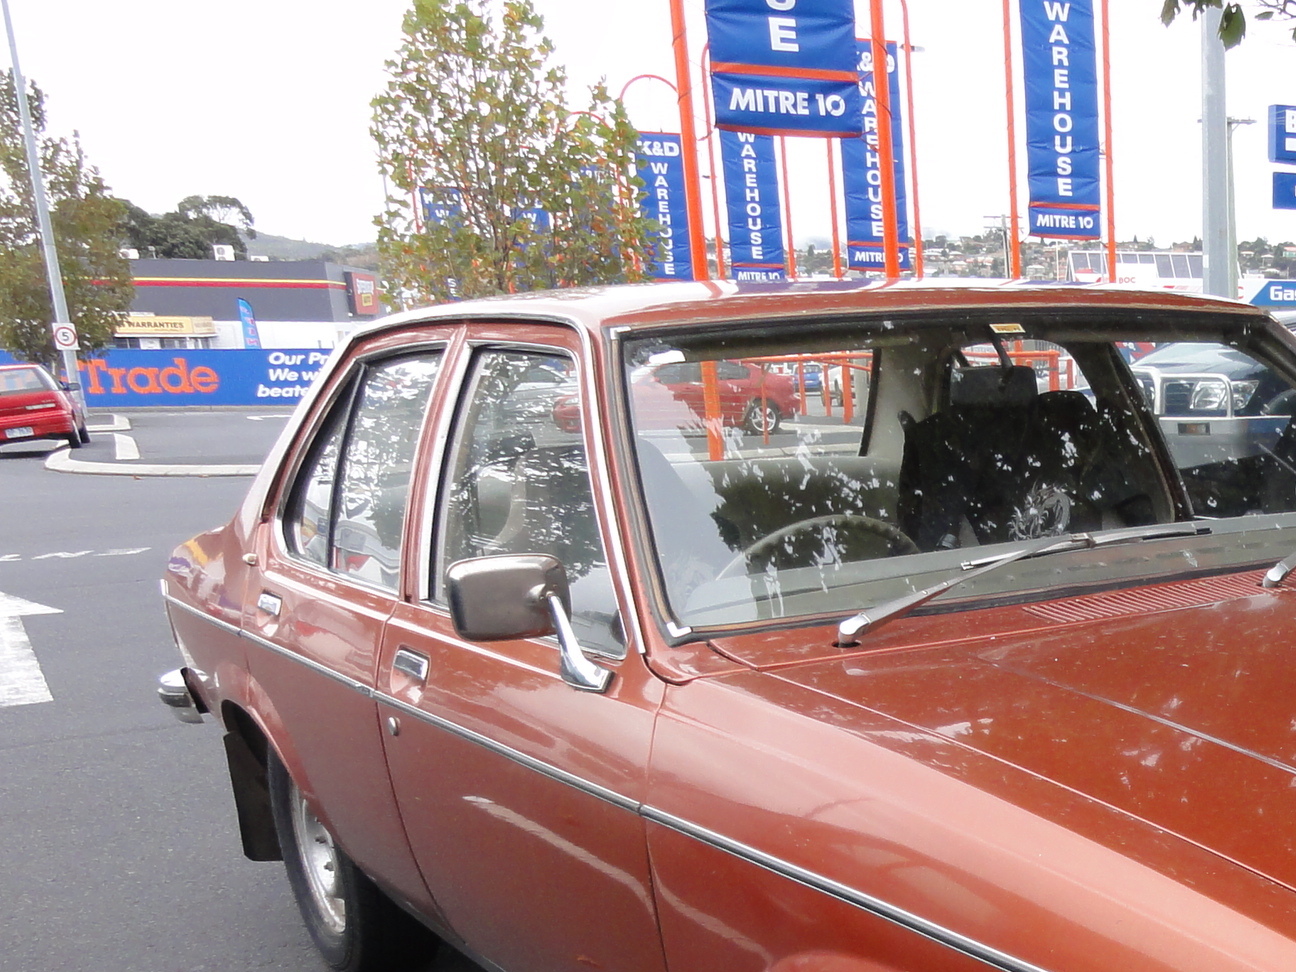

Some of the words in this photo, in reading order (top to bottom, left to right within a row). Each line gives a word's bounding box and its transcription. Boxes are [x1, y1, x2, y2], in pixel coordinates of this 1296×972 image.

[729, 88, 810, 115] MITRE
[815, 94, 846, 116] 10
[1043, 1, 1074, 197] WAREHOUSE
[636, 141, 680, 157] K&D
[737, 131, 763, 260] WAREHOUSE
[1036, 213, 1076, 229] MITRE
[1078, 215, 1094, 229] 10
[61, 331, 70, 342] 5
[269, 352, 306, 365] Our
[77, 358, 219, 394] Trade
[269, 368, 299, 382] We
